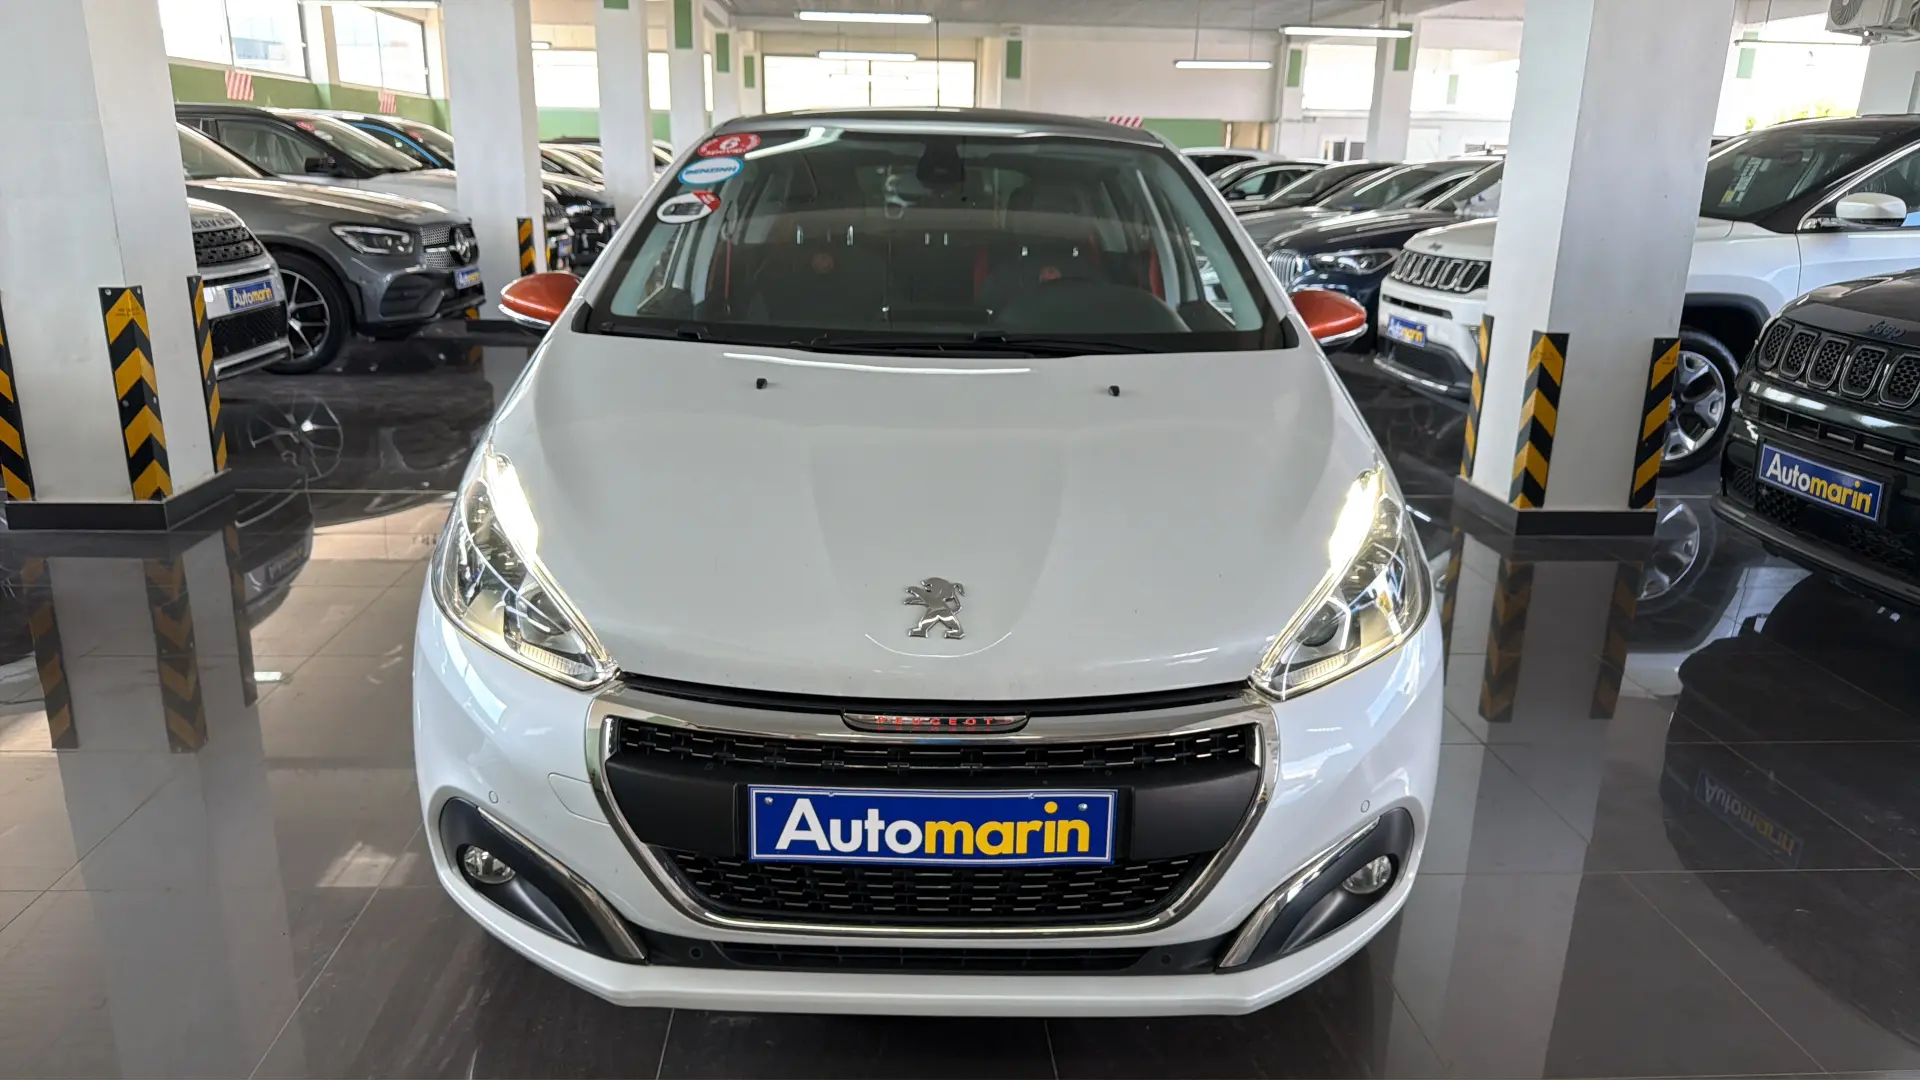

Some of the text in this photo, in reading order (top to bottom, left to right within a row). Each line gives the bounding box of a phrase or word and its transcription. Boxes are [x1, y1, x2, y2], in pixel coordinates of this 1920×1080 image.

[233, 282, 273, 309] Automarin
[1765, 452, 1872, 513] Automarin
[876, 716, 993, 726] PEUGEOT
[775, 798, 1090, 855] Automarin
